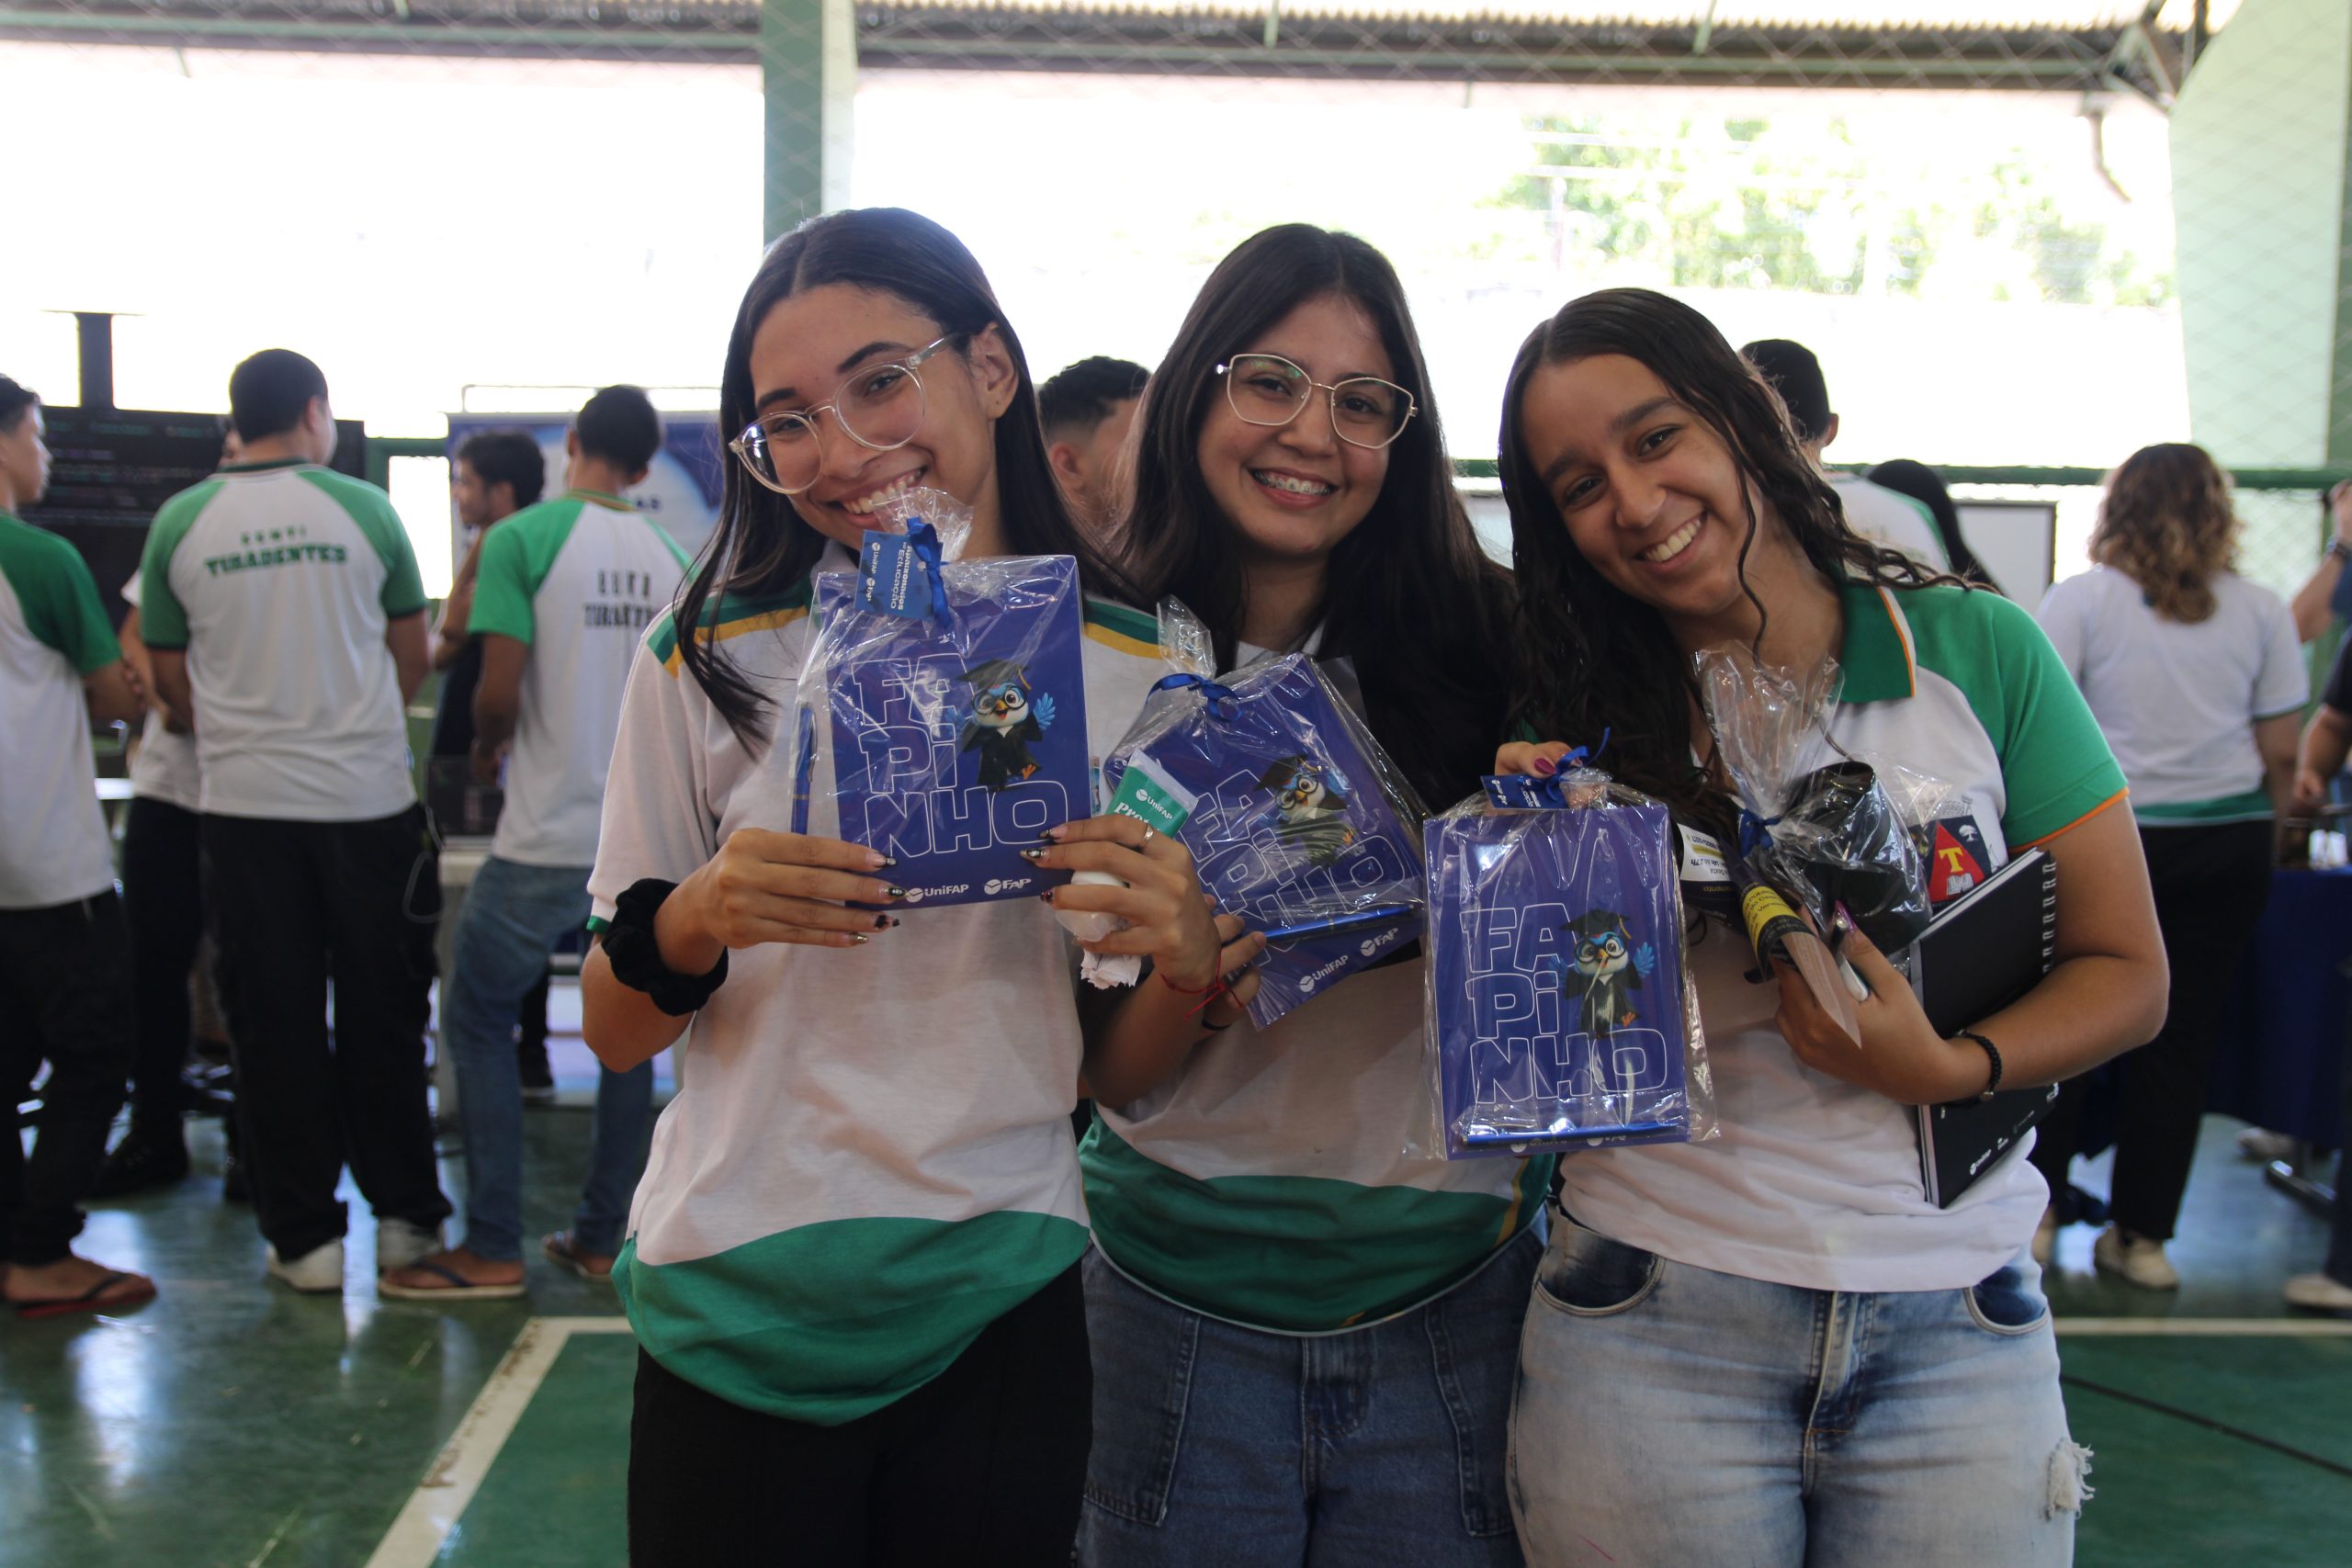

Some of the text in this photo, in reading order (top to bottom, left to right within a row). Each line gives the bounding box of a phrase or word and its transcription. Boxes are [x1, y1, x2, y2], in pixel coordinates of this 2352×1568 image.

[865, 781, 1068, 858] NHO
[1147, 796, 1172, 819] UniFAP
[1938, 847, 1963, 874] T
[924, 878, 1032, 897] UniFAP FAP
[1312, 928, 1398, 981] UniFAP FAP
[1471, 1028, 1667, 1104] NHO
